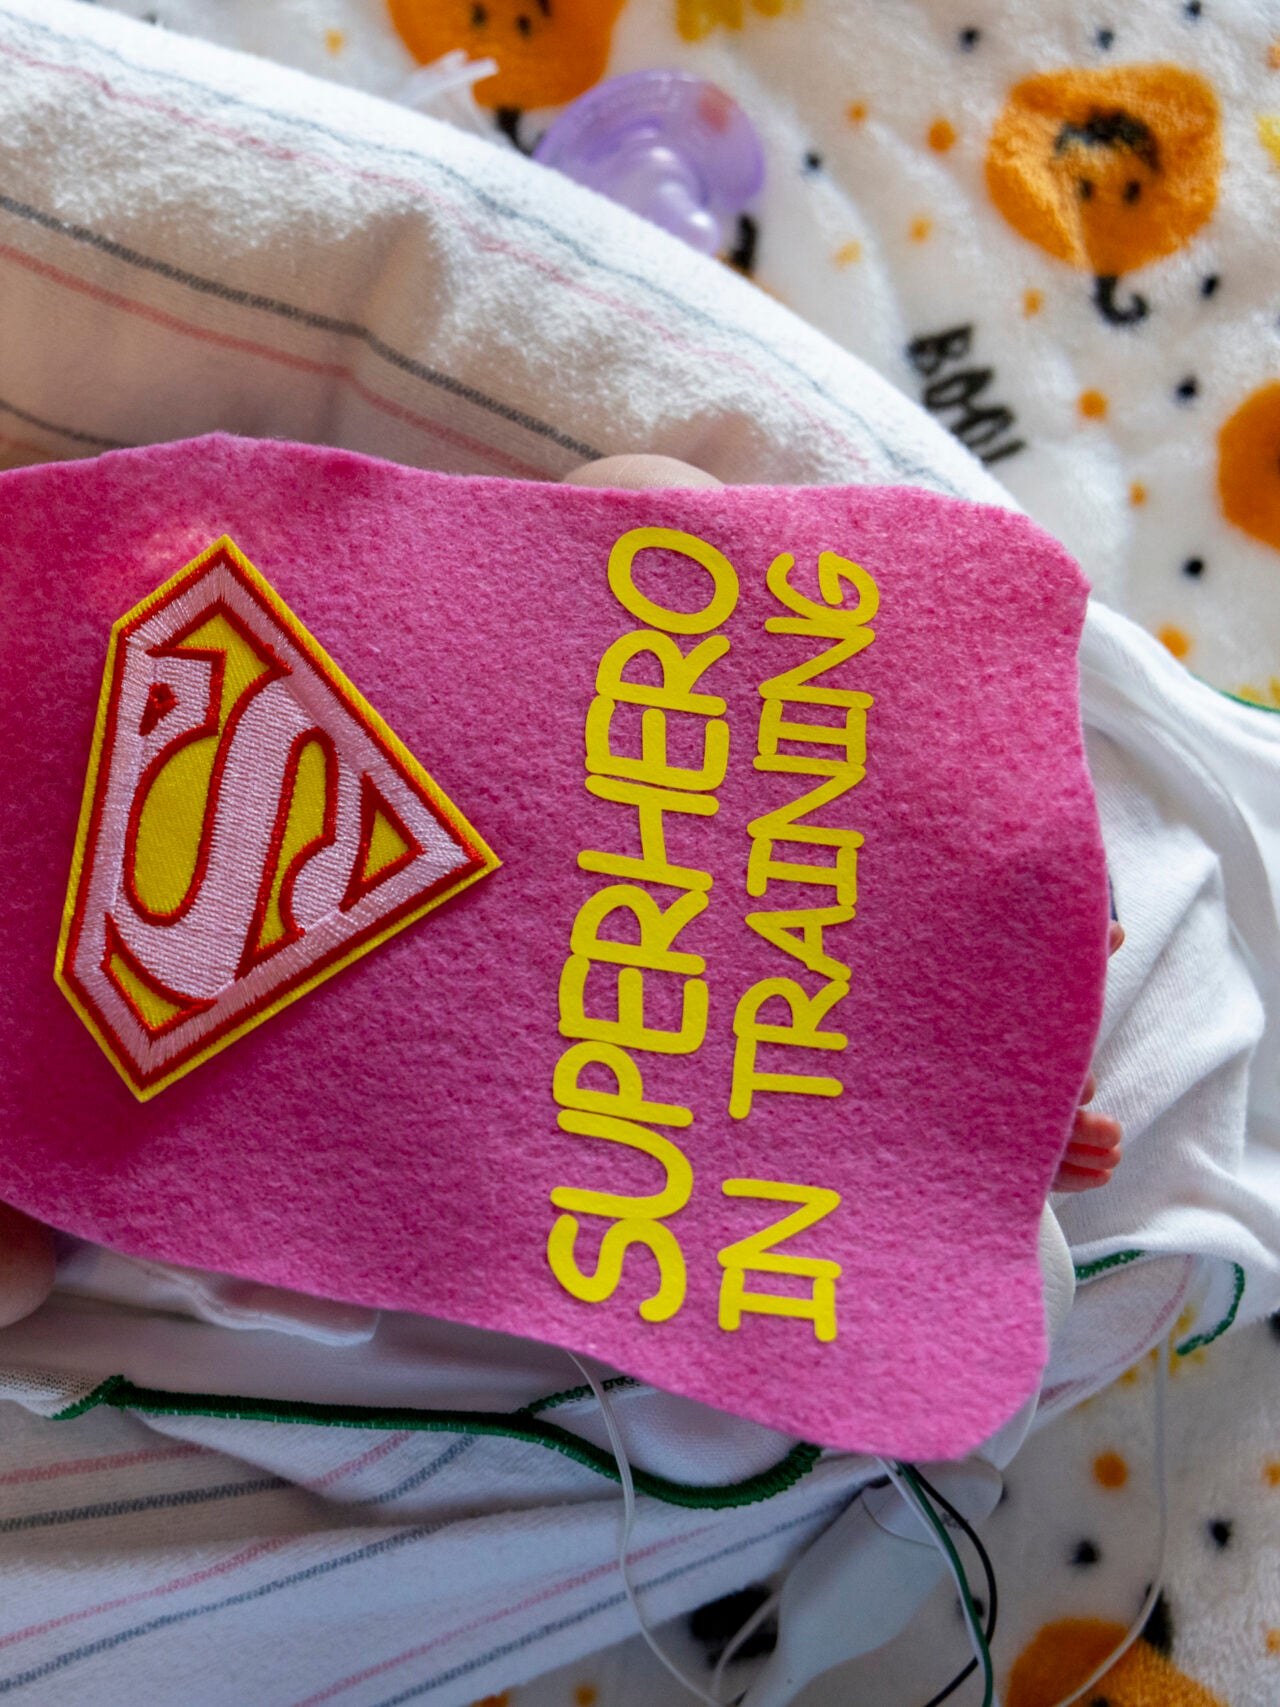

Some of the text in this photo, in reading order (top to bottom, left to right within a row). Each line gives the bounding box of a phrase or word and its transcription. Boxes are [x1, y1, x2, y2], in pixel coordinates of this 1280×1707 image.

[547, 527, 740, 1321] SUPERHERO
[718, 551, 880, 1342] IN TRAINING
